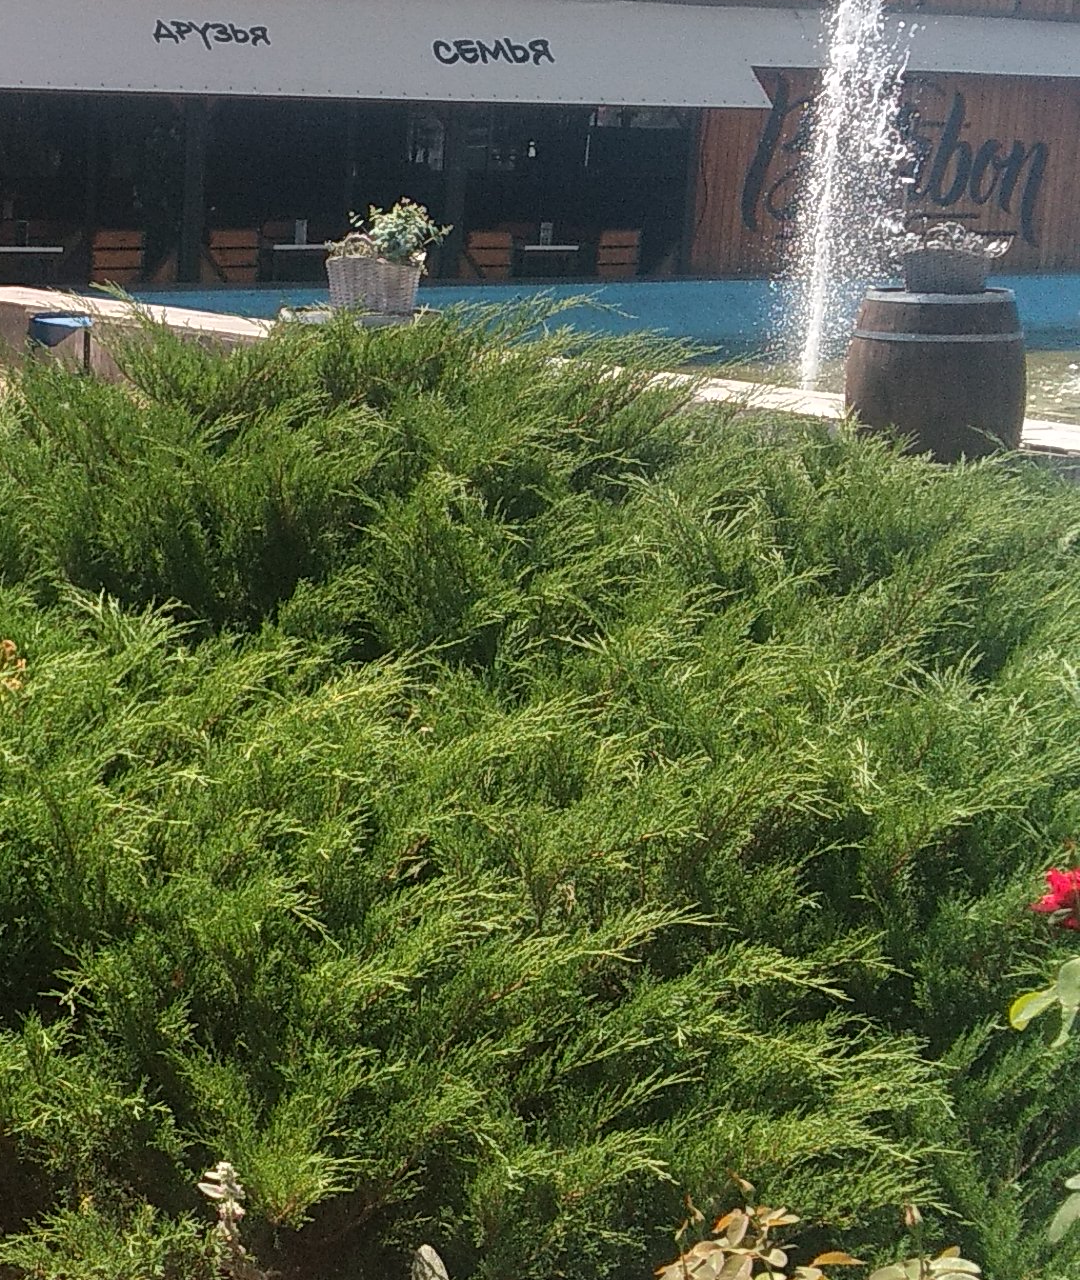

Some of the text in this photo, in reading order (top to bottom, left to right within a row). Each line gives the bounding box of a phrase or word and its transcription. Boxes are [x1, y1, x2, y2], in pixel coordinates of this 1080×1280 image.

[153, 19, 272, 50] ДРУЗЬЯ
[431, 36, 556, 63] СЕМЬЯ
[741, 70, 1049, 247] Brbon
